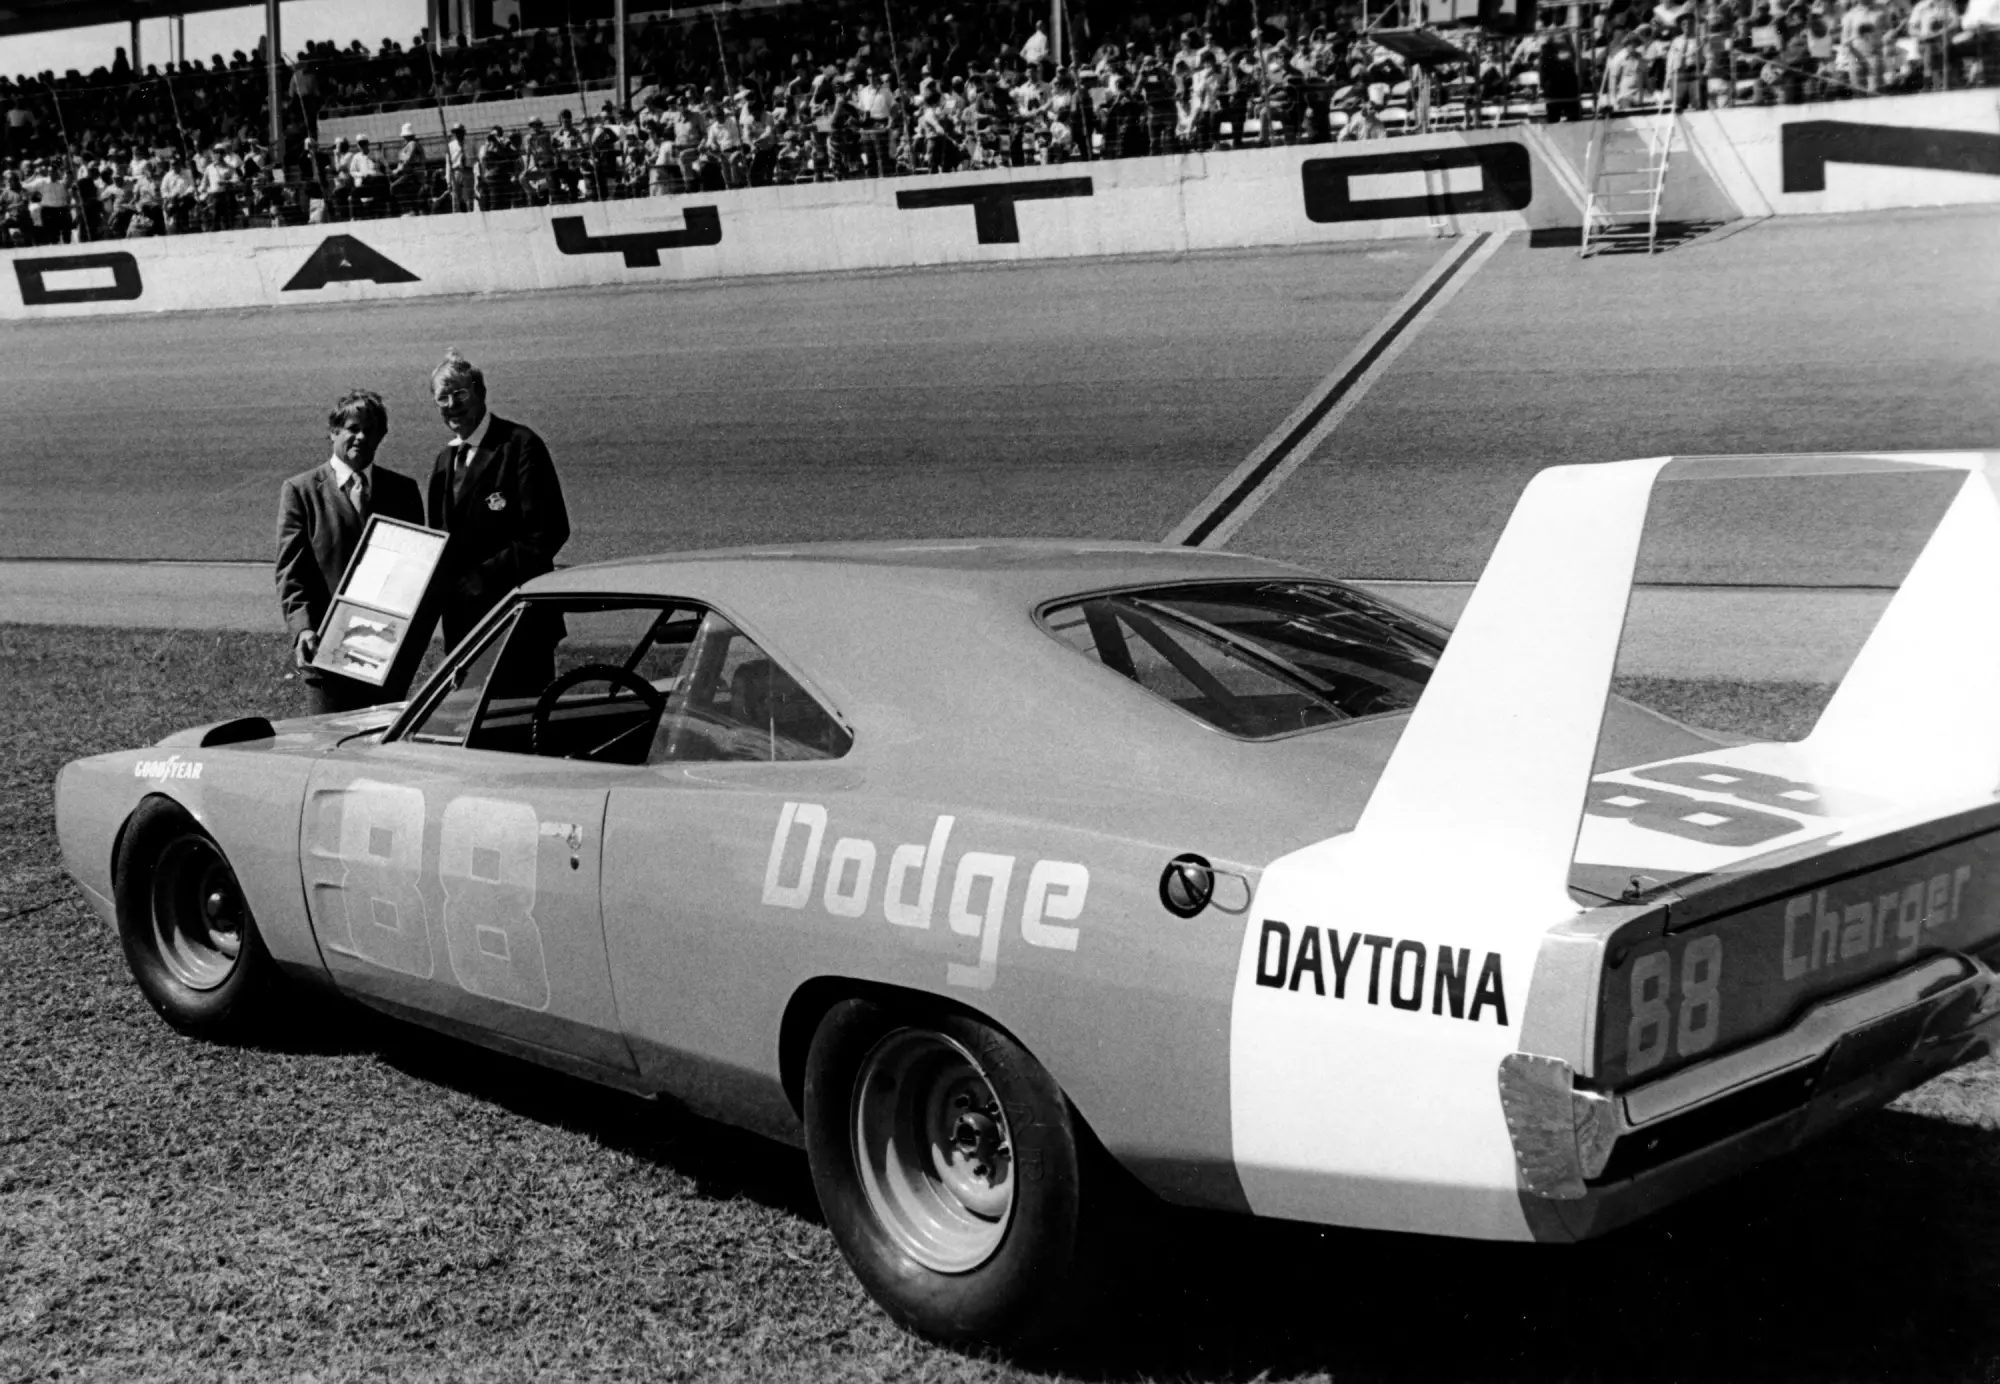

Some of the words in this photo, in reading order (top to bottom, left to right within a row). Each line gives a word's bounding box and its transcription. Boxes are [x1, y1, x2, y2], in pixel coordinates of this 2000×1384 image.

[135, 755, 203, 783] GOODYEAR
[1585, 761, 1893, 847] 88
[340, 777, 551, 1012] 88
[761, 801, 1090, 991] Dodge
[1783, 865, 1972, 981] Charger
[1256, 919, 1510, 1027] DAYTONA
[1626, 935, 1722, 1077] 88
